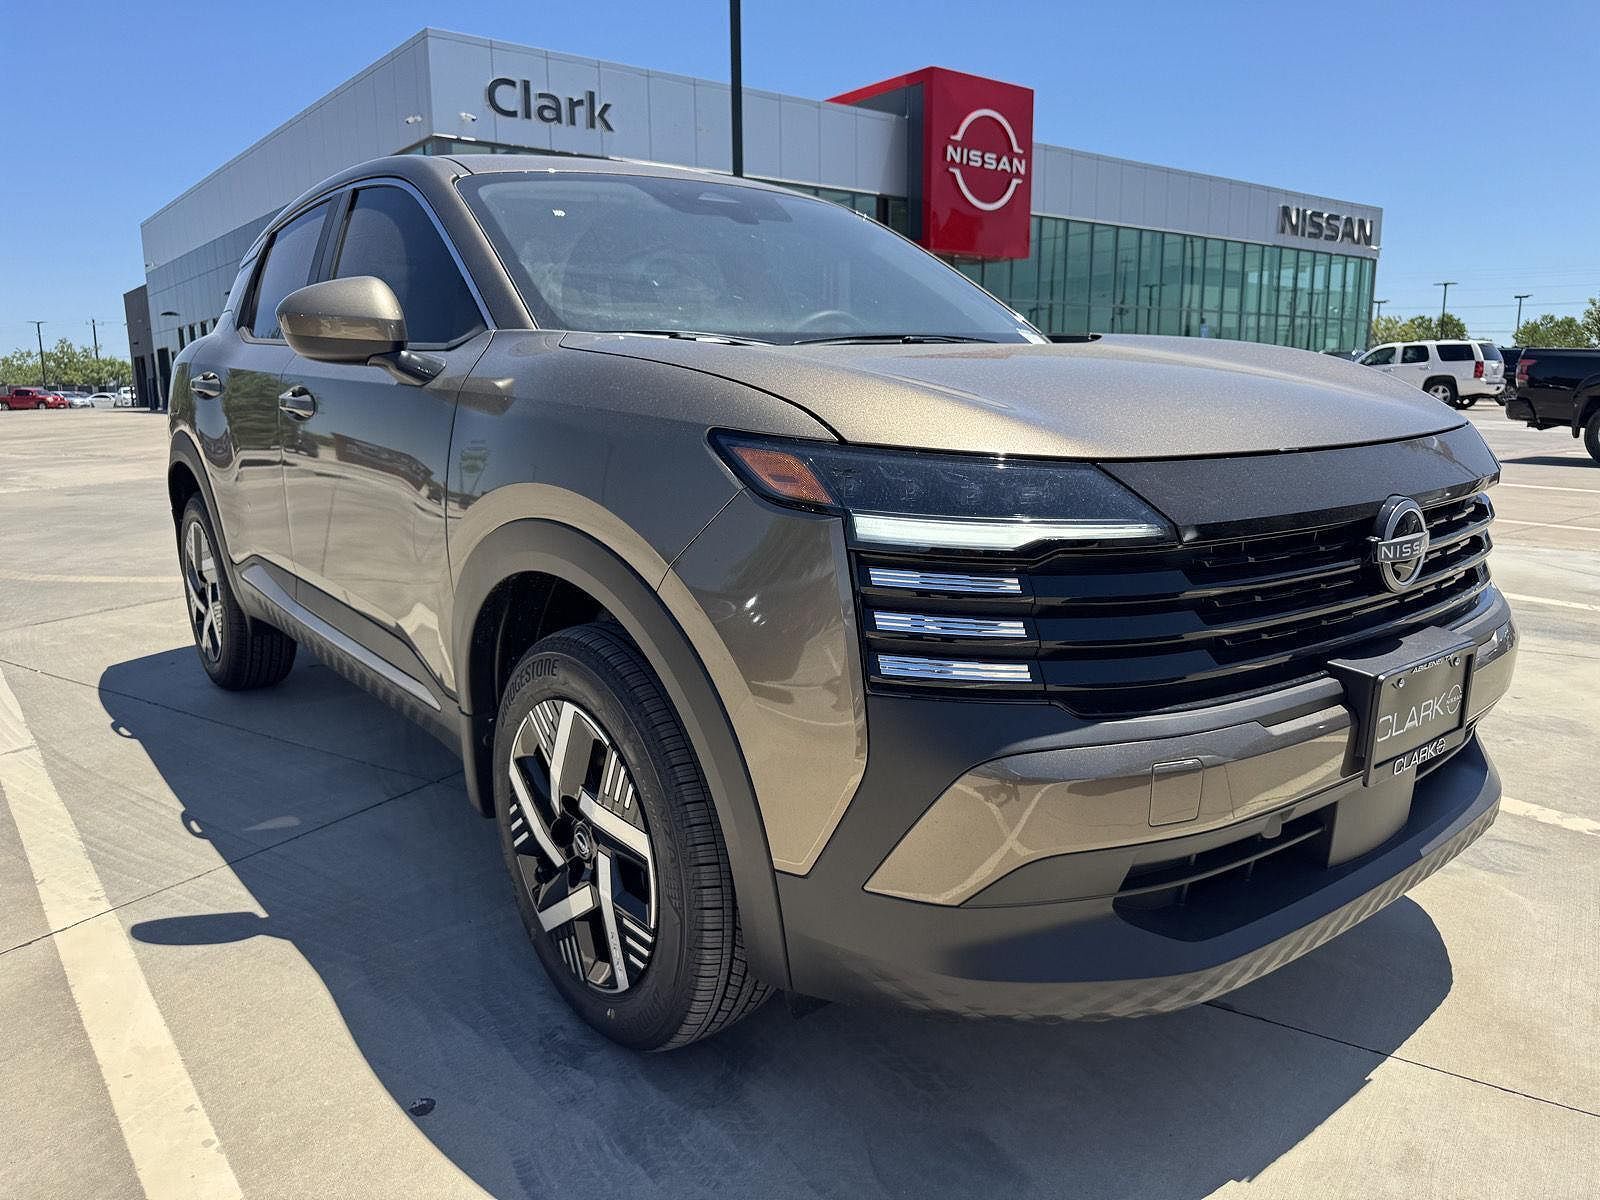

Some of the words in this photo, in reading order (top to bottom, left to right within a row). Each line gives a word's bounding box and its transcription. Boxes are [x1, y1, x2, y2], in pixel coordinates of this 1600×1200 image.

[486, 77, 615, 132] Clark
[946, 145, 1026, 175] NISSAN
[1278, 204, 1373, 246] NISSAN
[1376, 692, 1446, 742] CLARK
[1393, 740, 1437, 775] CLARK
